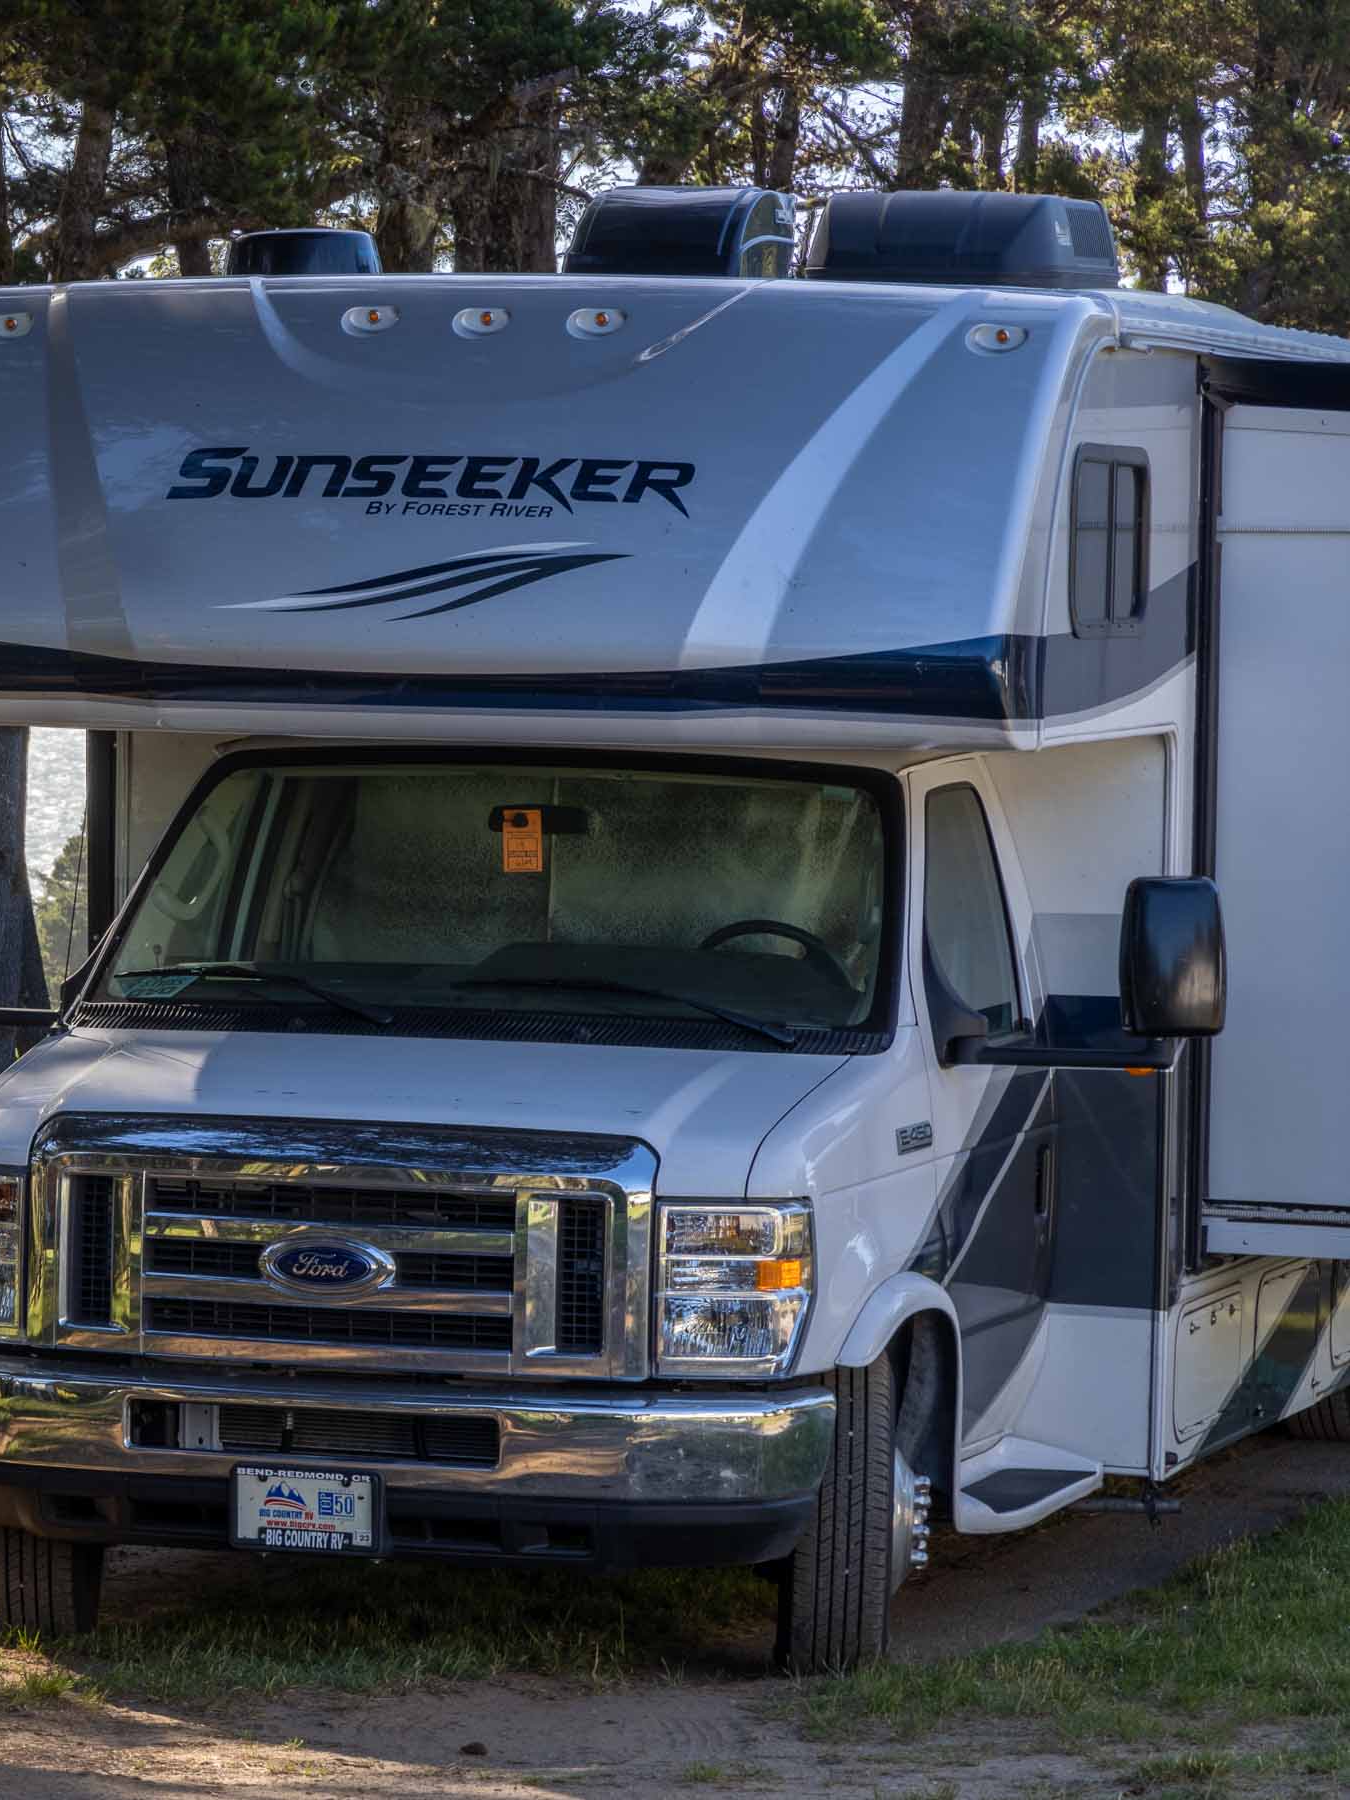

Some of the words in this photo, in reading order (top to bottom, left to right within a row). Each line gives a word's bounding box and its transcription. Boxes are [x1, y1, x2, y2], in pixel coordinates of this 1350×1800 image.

[166, 446, 696, 519] SUNSEEKER
[402, 501, 485, 517] FOREST
[490, 503, 554, 518] RIVER
[292, 1251, 350, 1278] Ford
[320, 1493, 332, 1515] TOP
[334, 1494, 354, 1515] 50
[304, 1511, 314, 1521] RV
[266, 1528, 282, 1546] BIG
[284, 1530, 329, 1549] COUNTRY
[330, 1533, 345, 1550] RV
